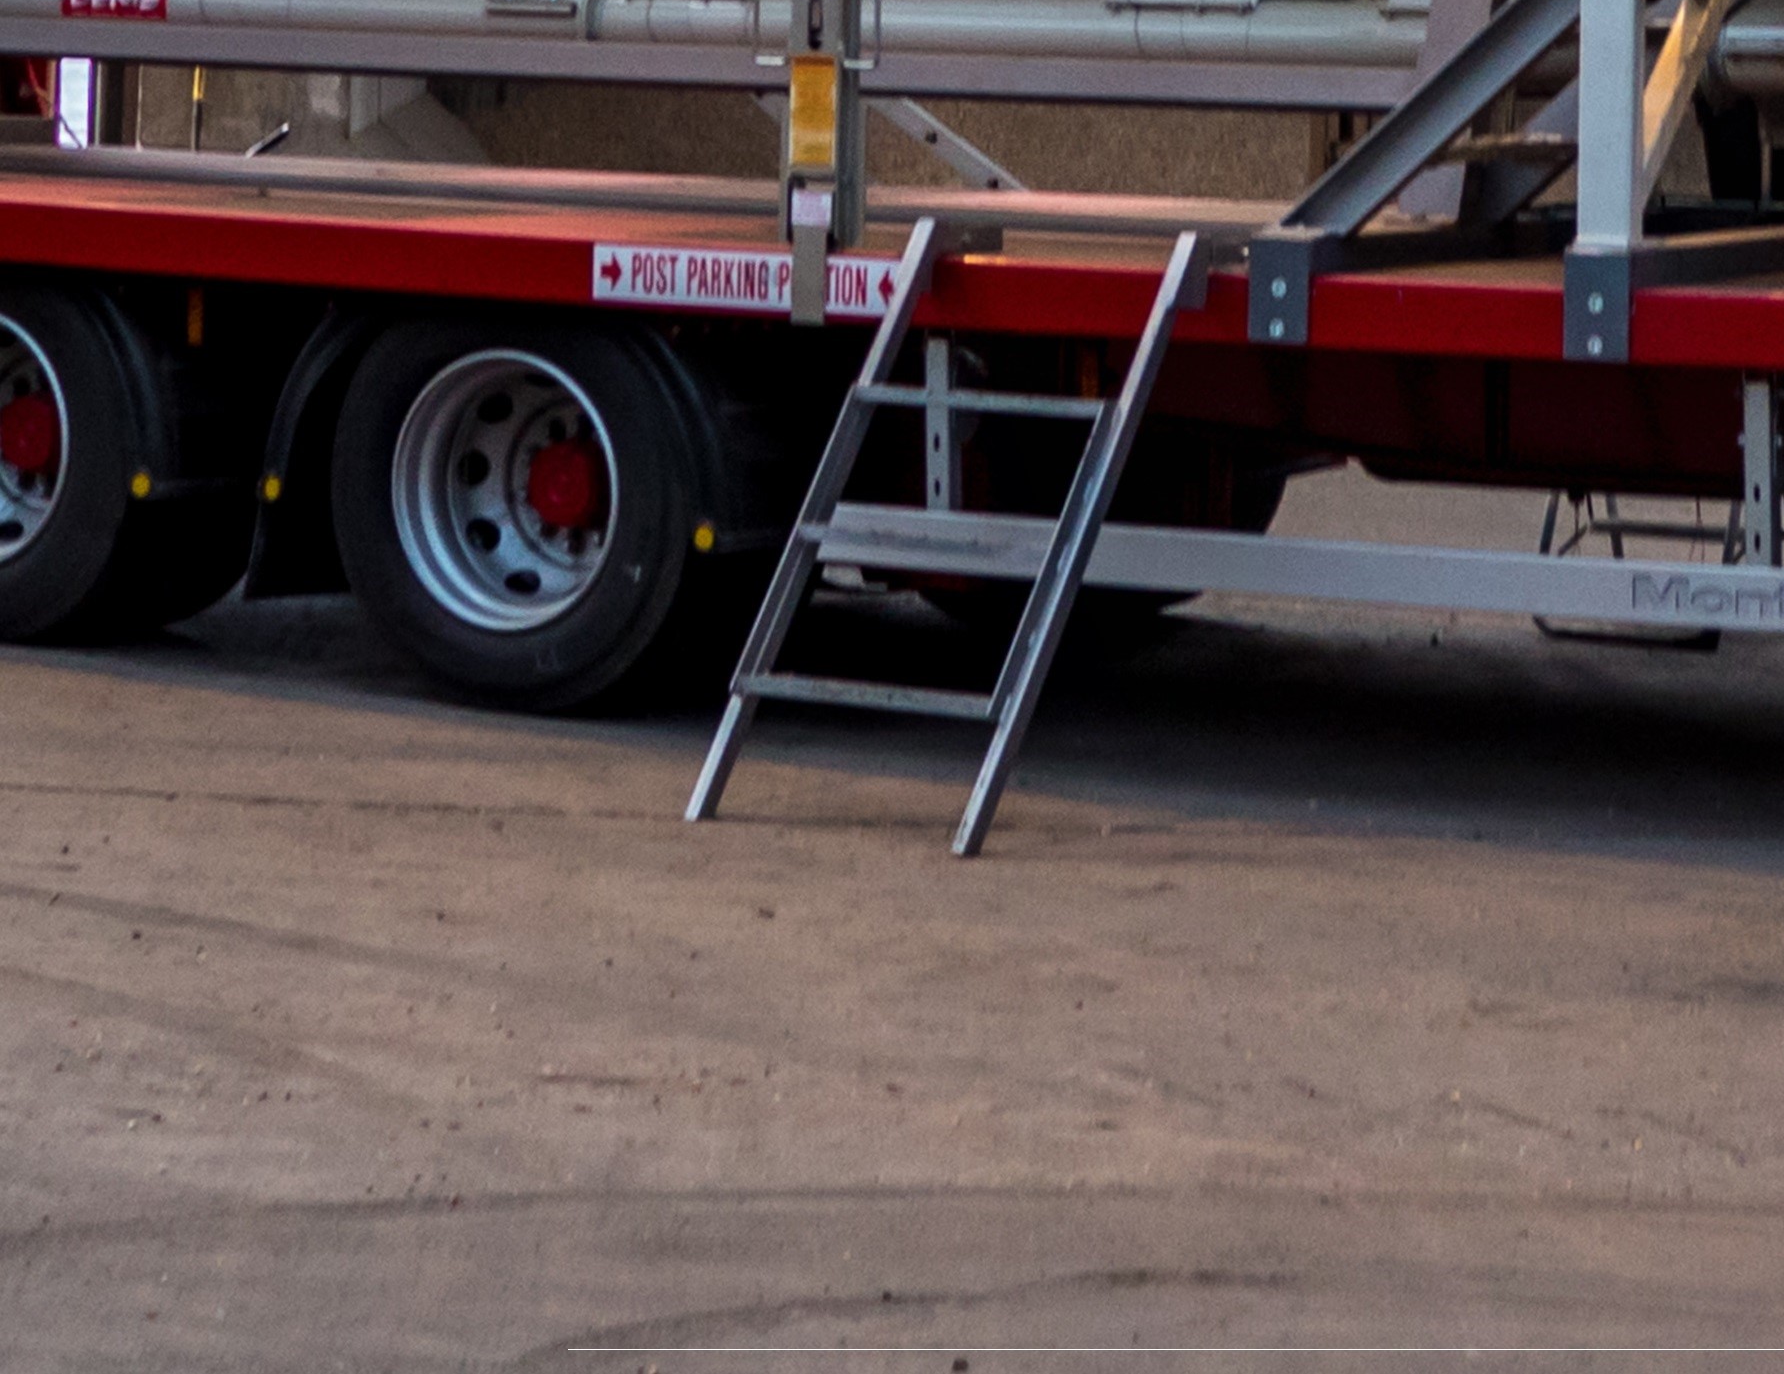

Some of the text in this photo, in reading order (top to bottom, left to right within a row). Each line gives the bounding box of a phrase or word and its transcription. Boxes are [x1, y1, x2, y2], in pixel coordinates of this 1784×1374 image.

[631, 253, 868, 307] POST PARKING PTION
